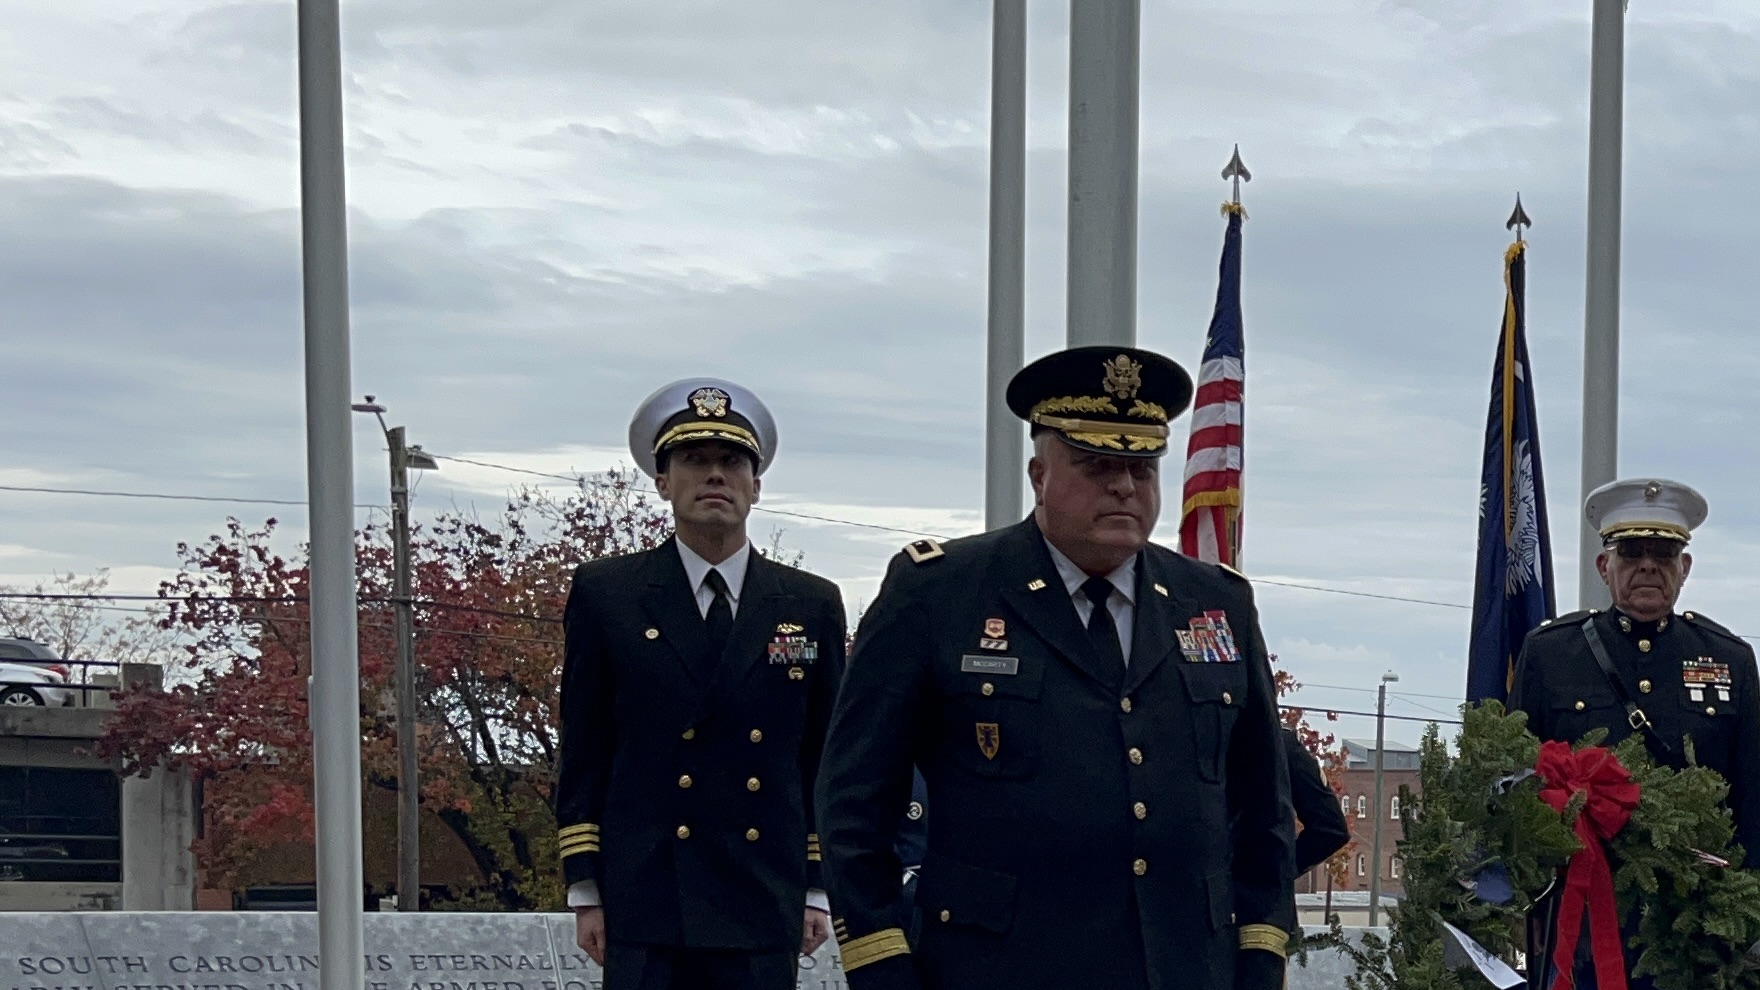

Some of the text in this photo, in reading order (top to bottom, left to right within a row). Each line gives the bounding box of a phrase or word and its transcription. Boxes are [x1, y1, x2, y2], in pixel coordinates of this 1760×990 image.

[18, 954, 590, 975] SOUTH CAROLIN IS ETERNALLY
